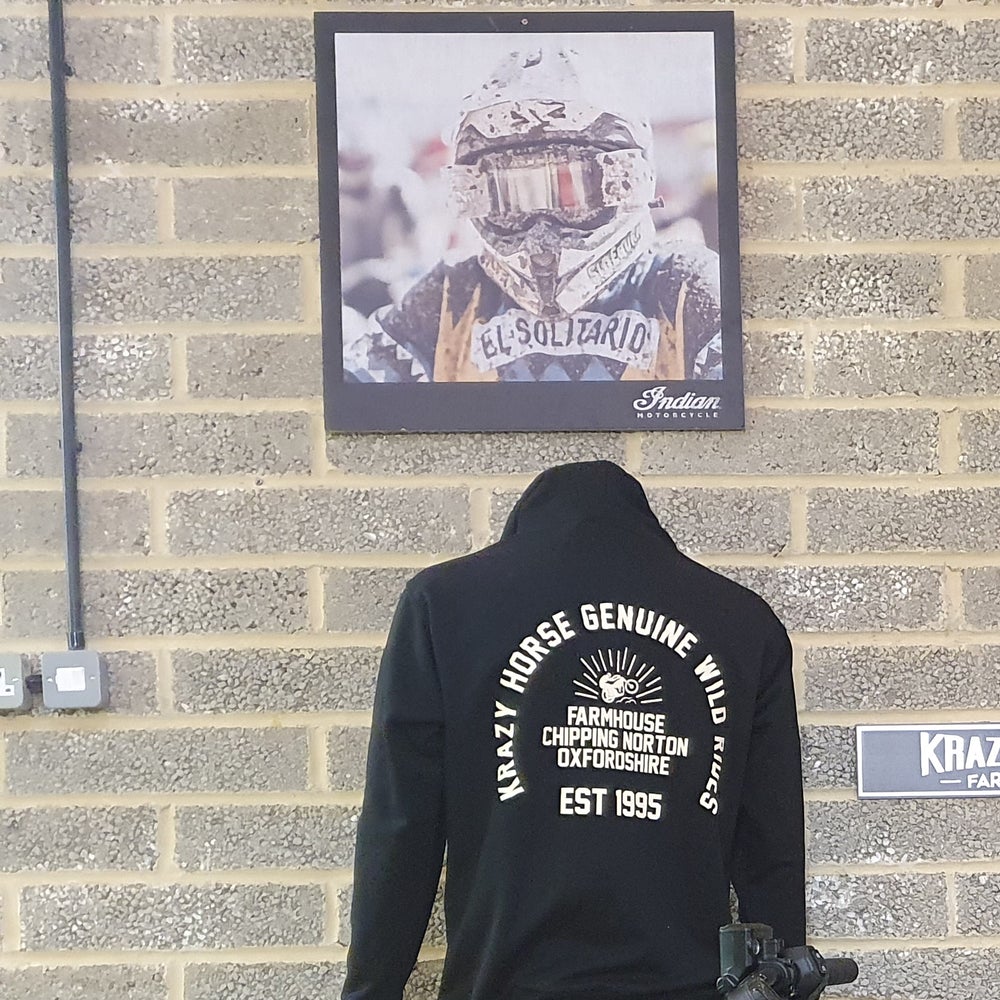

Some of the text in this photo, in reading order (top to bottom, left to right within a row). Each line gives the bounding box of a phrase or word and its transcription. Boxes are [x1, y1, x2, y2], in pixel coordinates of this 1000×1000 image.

[480, 317, 647, 360] EL SOLITARIO
[632, 386, 721, 410] Indian
[580, 602, 699, 659] GENUINE
[500, 611, 576, 694] HORSE
[694, 654, 727, 725] WILD
[567, 705, 666, 734] FARMHOUSE
[494, 700, 525, 802] KRAZY
[541, 726, 689, 757] CHIPPING NORTON
[557, 748, 671, 776] OXFORDSHIRE
[560, 787, 663, 820] EST 1995
